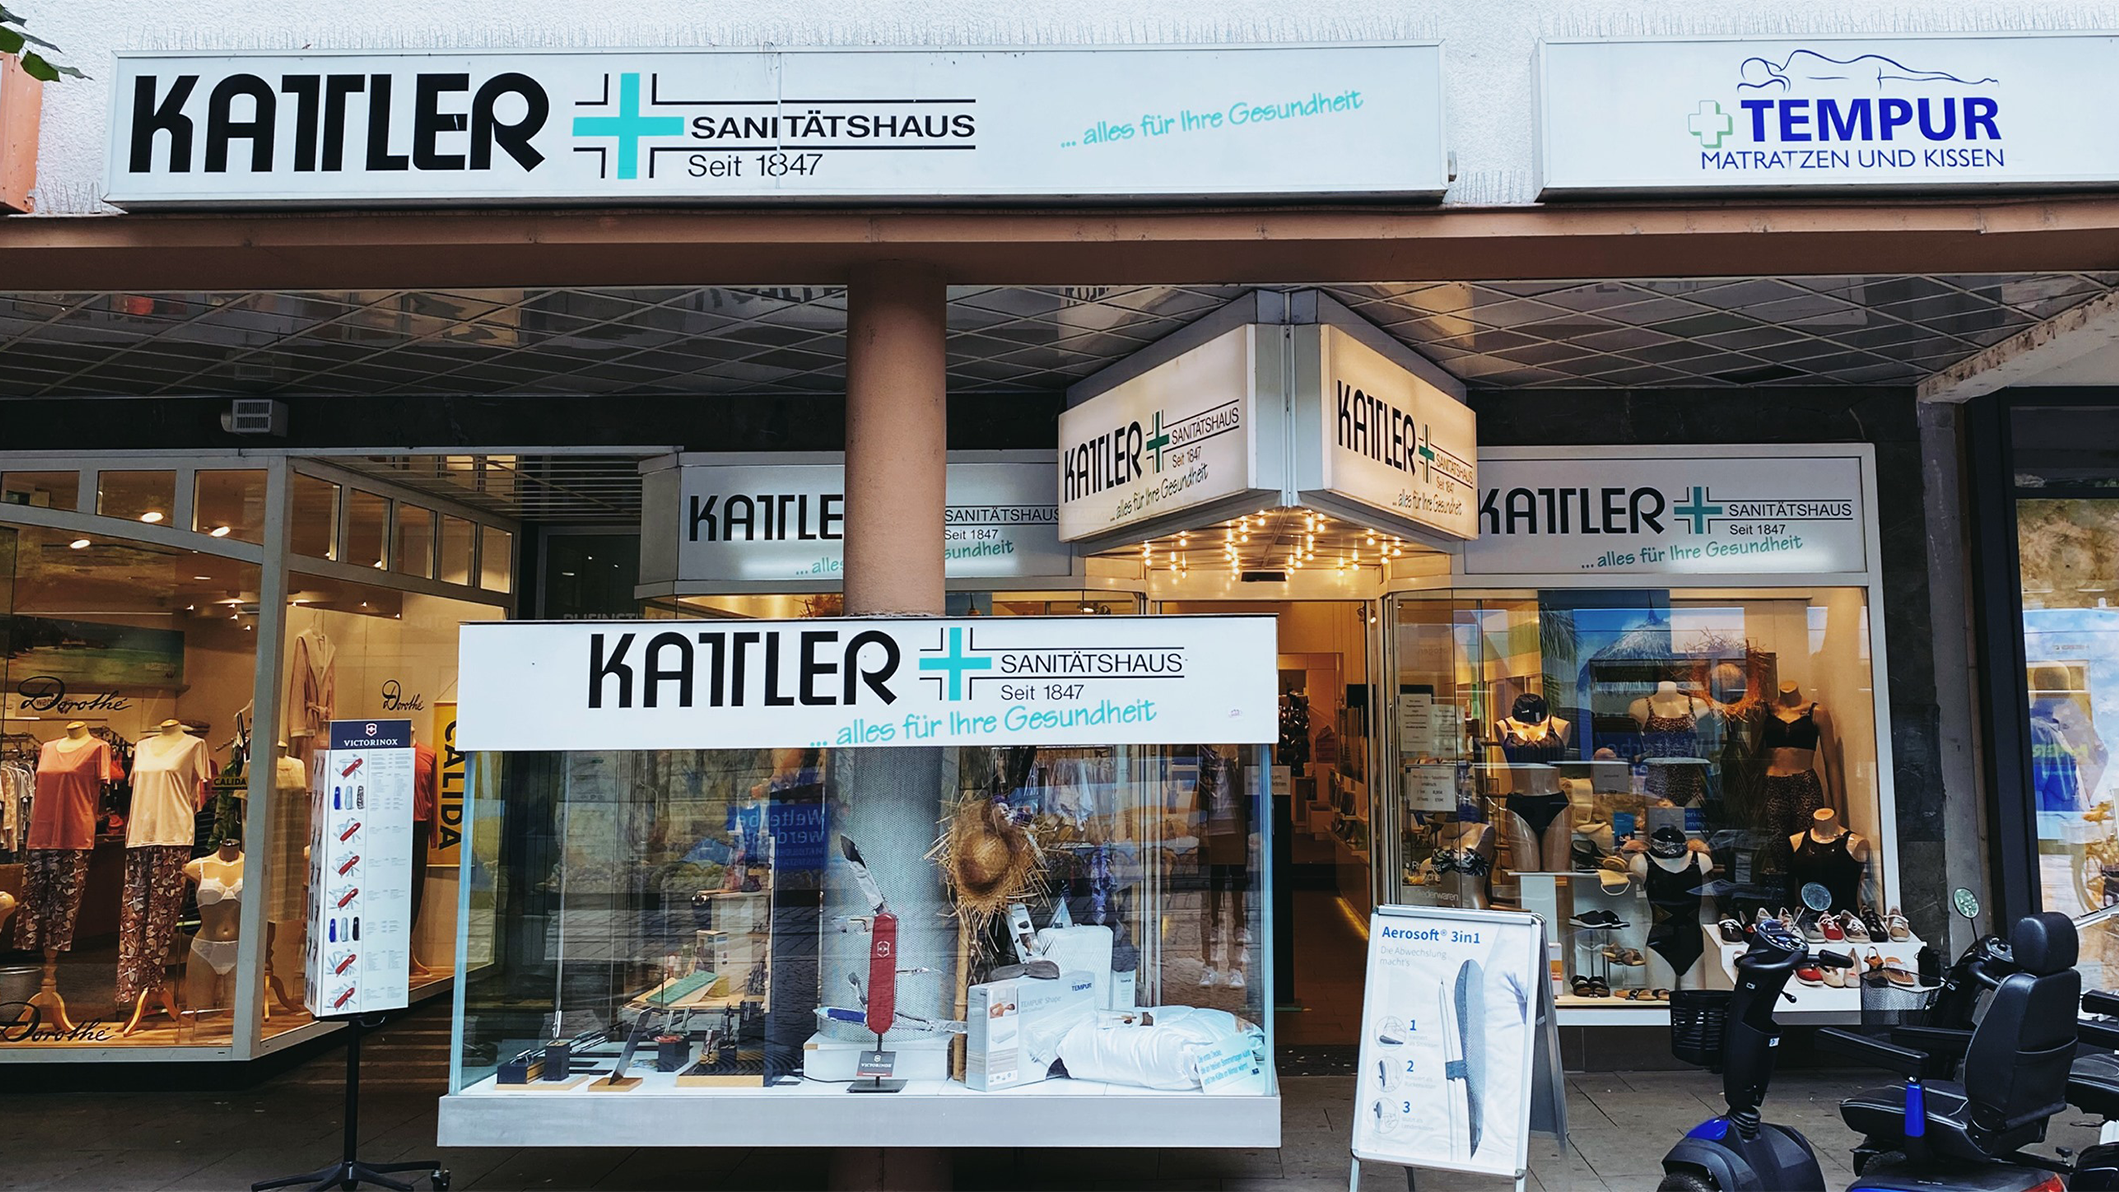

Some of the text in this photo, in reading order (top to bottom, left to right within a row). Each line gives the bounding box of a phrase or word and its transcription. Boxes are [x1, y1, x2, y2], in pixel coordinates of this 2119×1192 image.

[129, 72, 550, 173] KATTLER
[691, 110, 976, 139] SANITÄTSHAUS
[1083, 121, 1135, 145] alles
[1140, 114, 1175, 137] für
[1180, 110, 1223, 132] Ihre
[1228, 90, 1364, 125] Gesundheit
[1740, 97, 2002, 142] TEMPUR
[688, 153, 823, 177] Seit 1847
[1701, 148, 2004, 170] MATRATZEN UND KISSEN
[1171, 407, 1239, 444] SANITÄTSHAUS
[1337, 380, 1416, 476] KATTLER
[1064, 420, 1142, 503] KATTLER
[1478, 486, 1666, 535] KATTLER
[1728, 501, 1852, 517] SANITÄTSHAUS
[945, 529, 999, 540] Seit 1847
[1729, 523, 1786, 536] Seit 1847
[1640, 546, 1665, 564] für
[1669, 544, 1701, 561] Ihre
[1706, 535, 1803, 558] Gesundheit
[588, 630, 901, 708] KATTLER
[1000, 651, 1182, 674] SANITÄTSHAUS
[1001, 684, 1084, 701] Seit 1847
[836, 719, 896, 745] alles
[902, 714, 942, 739] für
[950, 710, 997, 736] Ihre
[1004, 698, 1157, 731] Gesundheit
[344, 738, 398, 747] VICTORINOX
[213, 777, 247, 786] CALIDA
[439, 720, 466, 850] CALIDA
[1451, 930, 1480, 944] 3in1
[1380, 946, 1447, 960] Die Abwechslung
[1071, 982, 1092, 992] TEMPUR
[1409, 1020, 1417, 1031] 1
[1406, 1060, 1414, 1072] 2
[1402, 1101, 1410, 1113] 3
